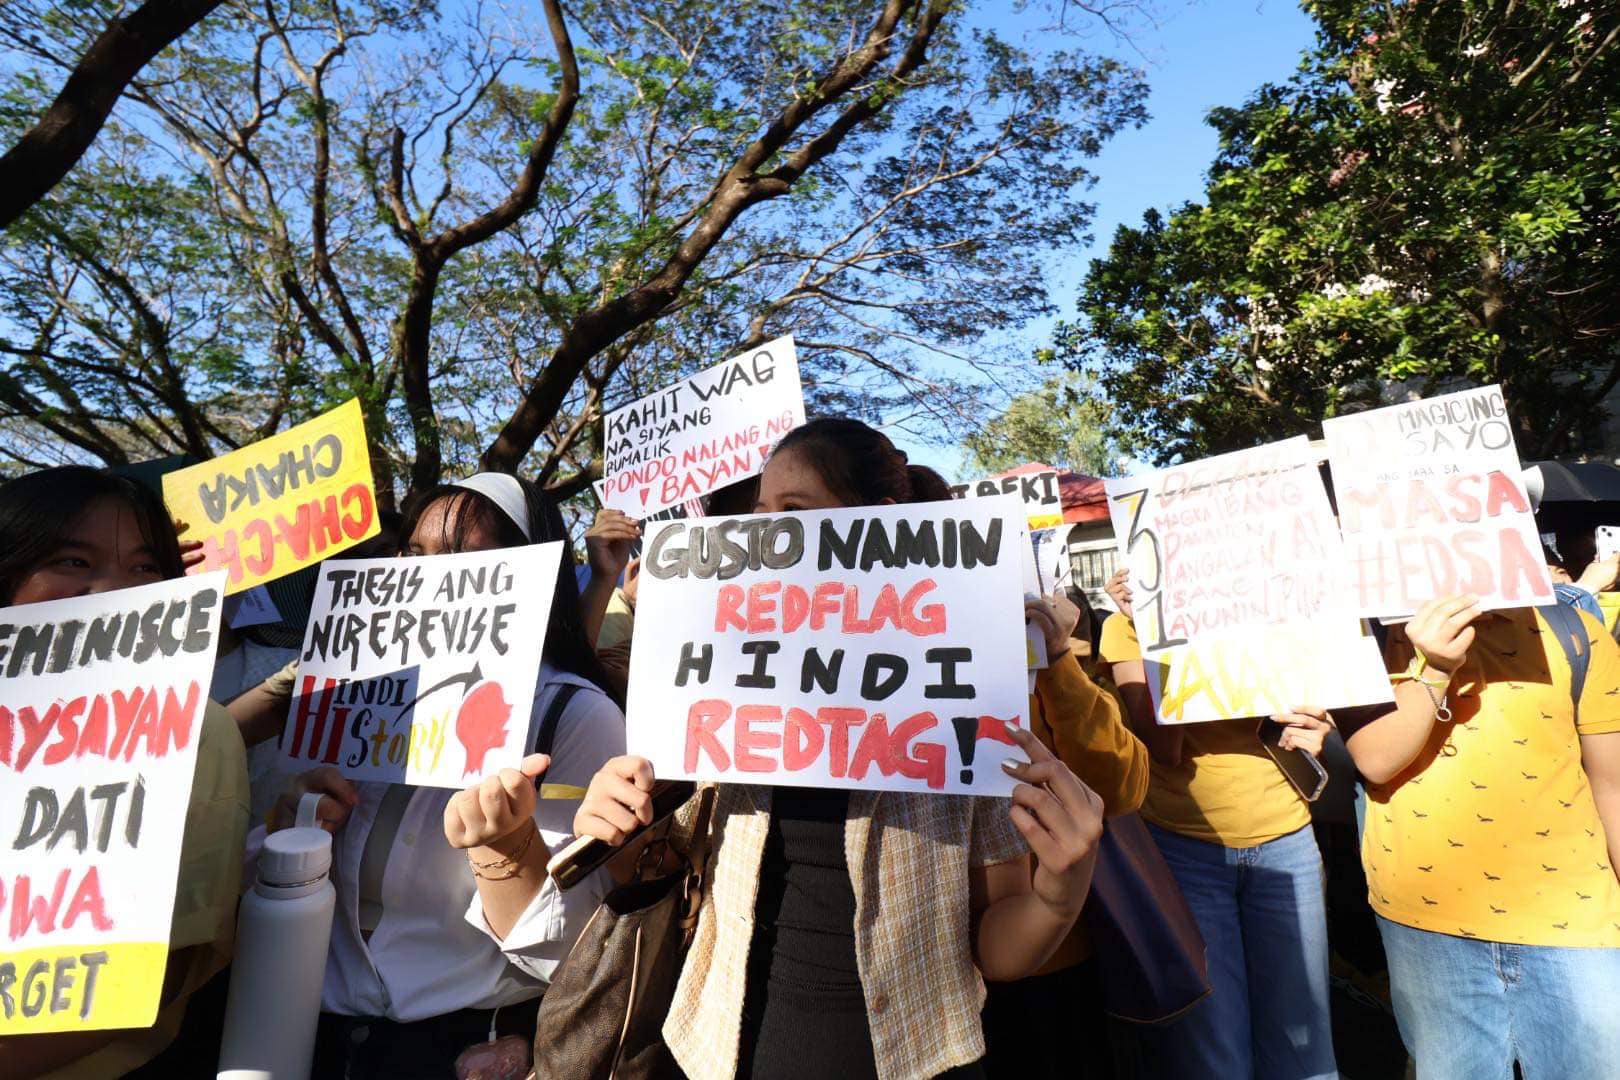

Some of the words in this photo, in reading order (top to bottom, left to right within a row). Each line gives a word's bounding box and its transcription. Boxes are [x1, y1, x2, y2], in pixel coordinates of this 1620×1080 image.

[607, 386, 683, 442] KAHIT
[689, 350, 775, 402] WAG
[604, 456, 677, 502] PONDO
[765, 410, 793, 439] NG
[606, 438, 632, 461] NA
[638, 407, 711, 445] SIYANG
[198, 434, 342, 524] CHAKA
[660, 450, 750, 505] BAYAN
[1343, 470, 1529, 532] MASA
[645, 517, 805, 580] GUSTO
[817, 517, 1003, 572] NAMIN
[326, 566, 424, 611] THESIS
[433, 561, 514, 602] ANG
[714, 578, 946, 636] REDFLAG
[303, 603, 517, 671] NIREREVISE
[674, 640, 976, 700] HINDI
[683, 699, 978, 789] REDTAG!
[12, 772, 147, 855] DATI
[0, 865, 115, 941] WA
[0, 951, 109, 1021] RGET
